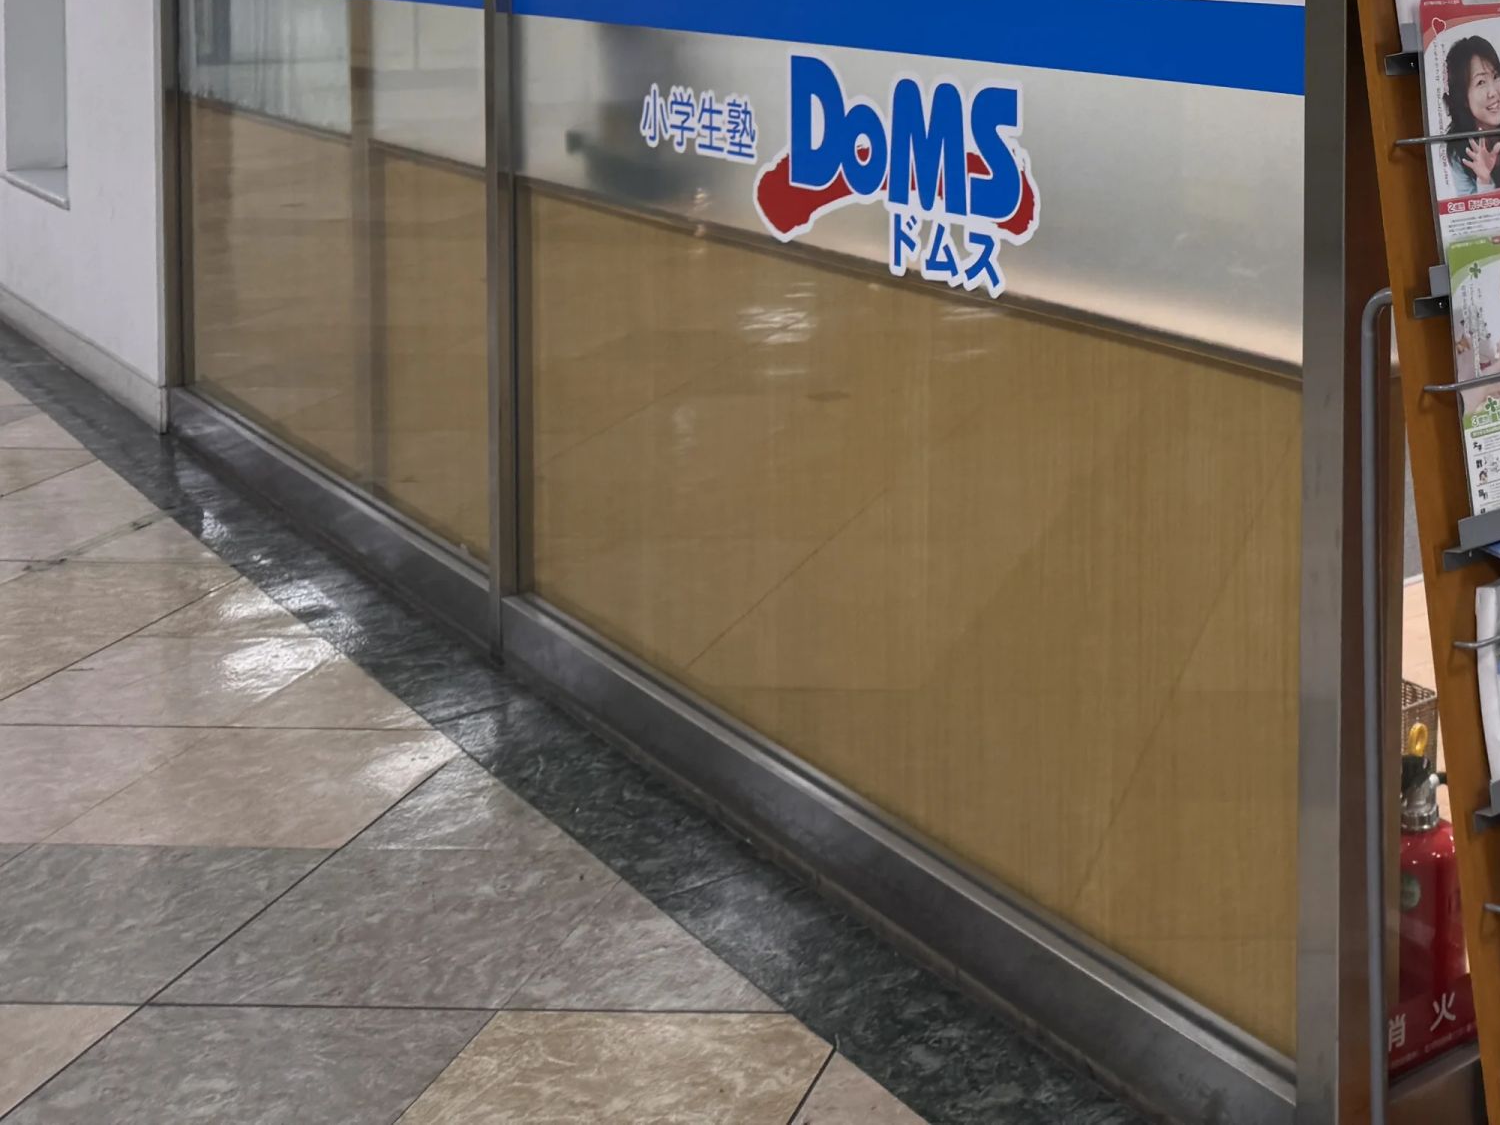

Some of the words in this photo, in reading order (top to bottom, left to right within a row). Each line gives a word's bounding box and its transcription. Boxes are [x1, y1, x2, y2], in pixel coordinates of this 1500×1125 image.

[641, 86, 757, 161] 小学生塾
[893, 213, 1001, 289] ドムス
